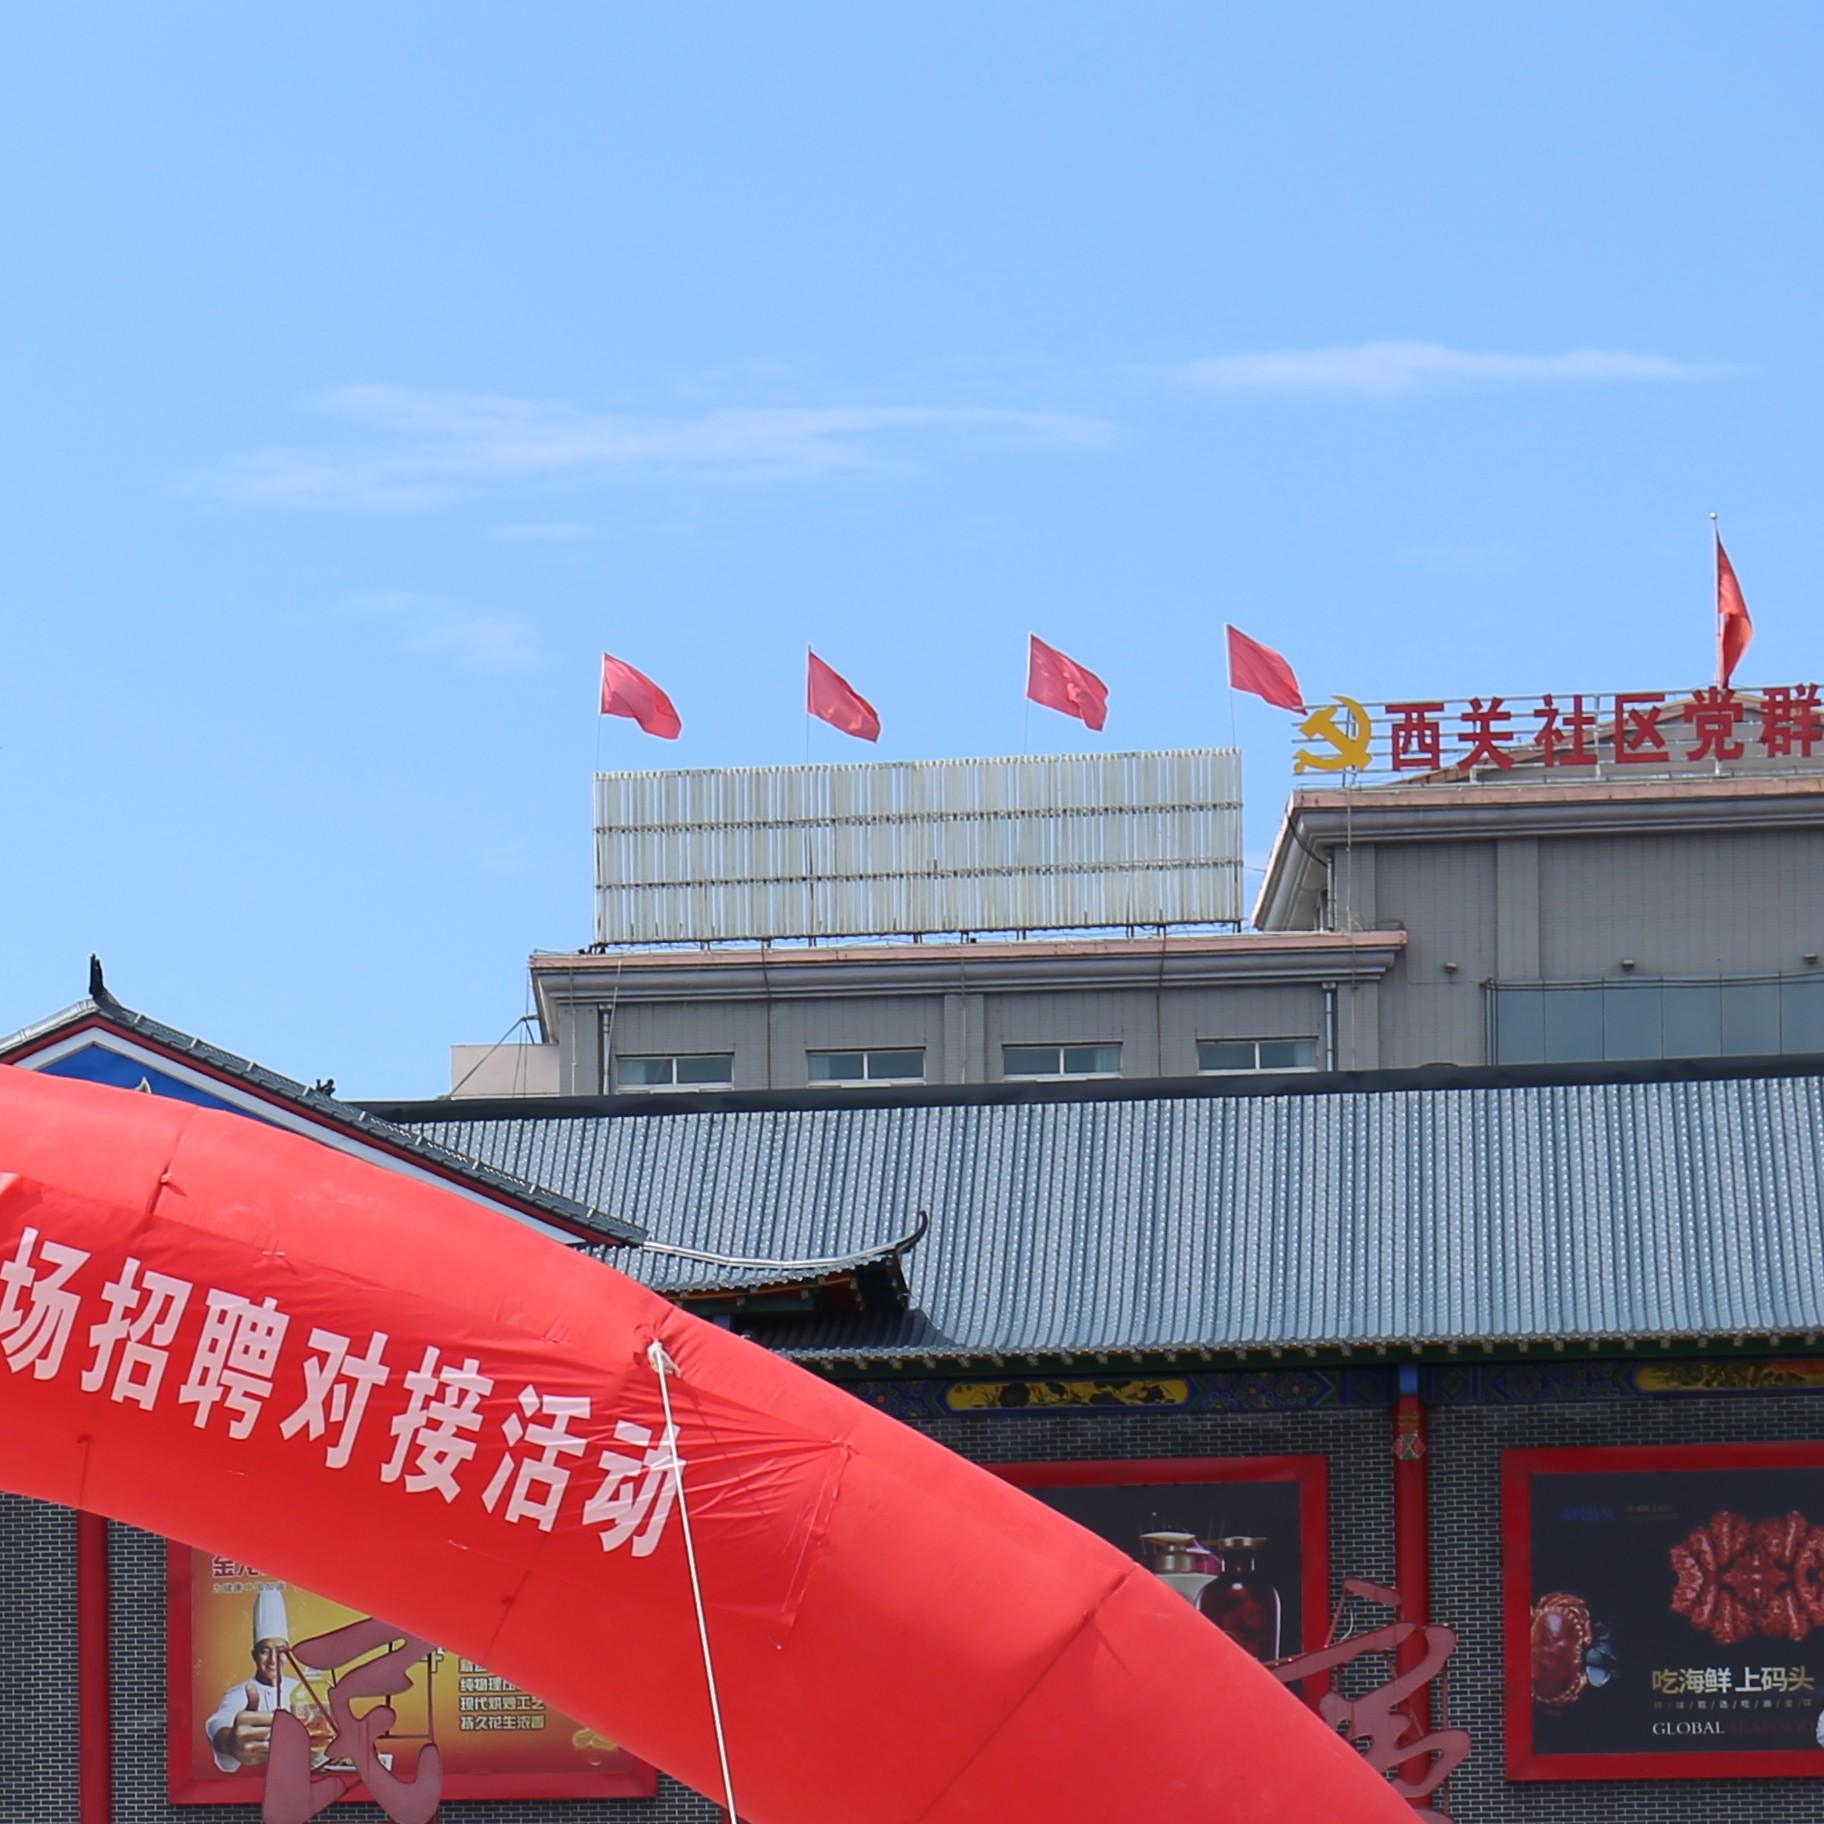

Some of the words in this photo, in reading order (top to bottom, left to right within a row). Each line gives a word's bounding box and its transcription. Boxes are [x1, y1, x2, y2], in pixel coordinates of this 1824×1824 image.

[1385, 683, 1823, 771] 西关社区党群
[1652, 1667, 1732, 1695] 吃海鲜
[1735, 1665, 1815, 1693] 上码头
[1652, 1721, 1725, 1735] GLOBAL
